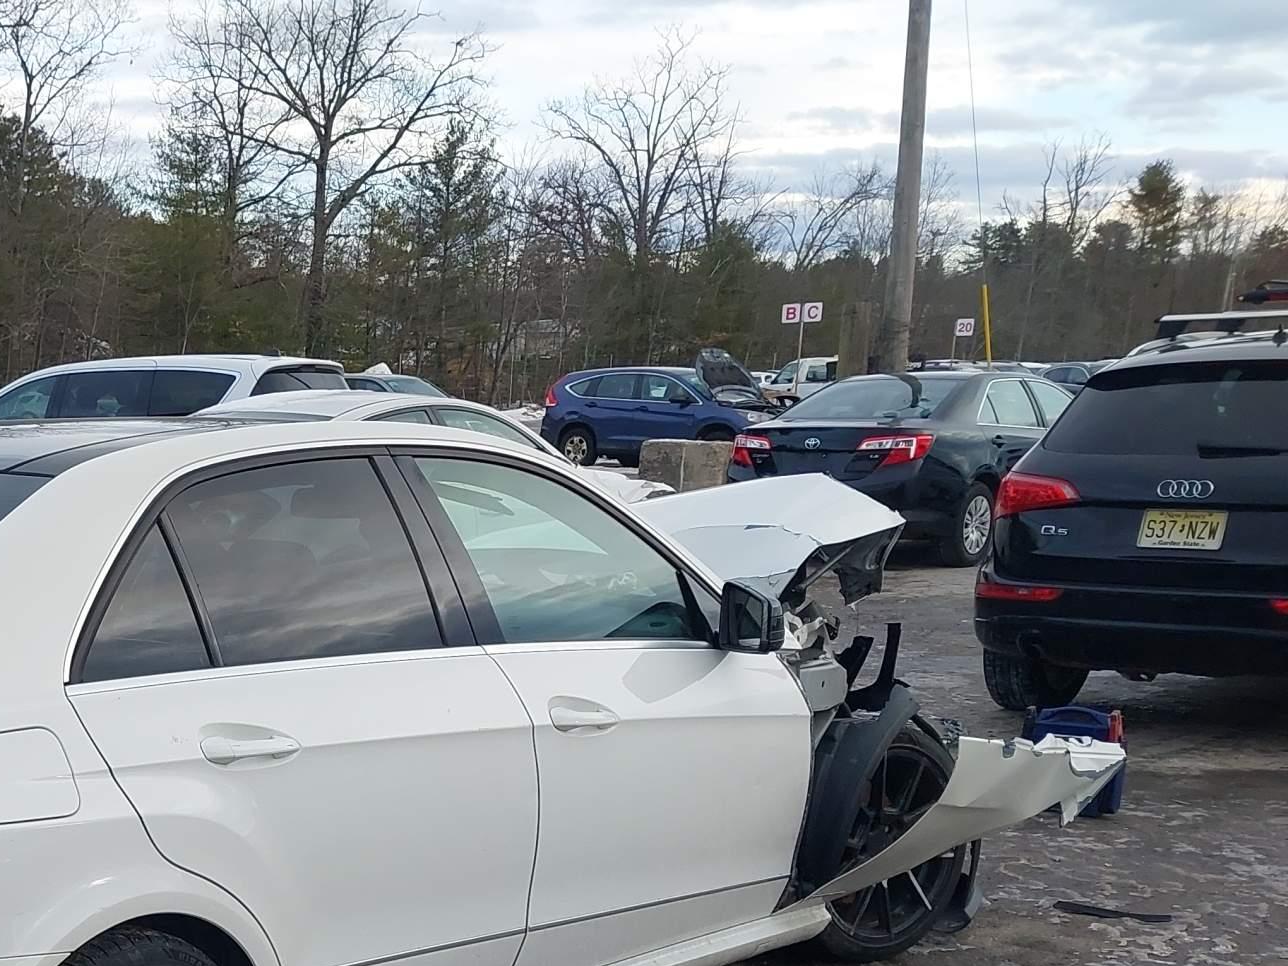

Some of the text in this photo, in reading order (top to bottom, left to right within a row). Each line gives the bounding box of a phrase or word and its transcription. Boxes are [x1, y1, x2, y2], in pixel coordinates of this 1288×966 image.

[785, 307, 797, 320] B
[807, 305, 819, 320] C
[958, 322, 973, 333] 20
[1040, 524, 1069, 536] Q5
